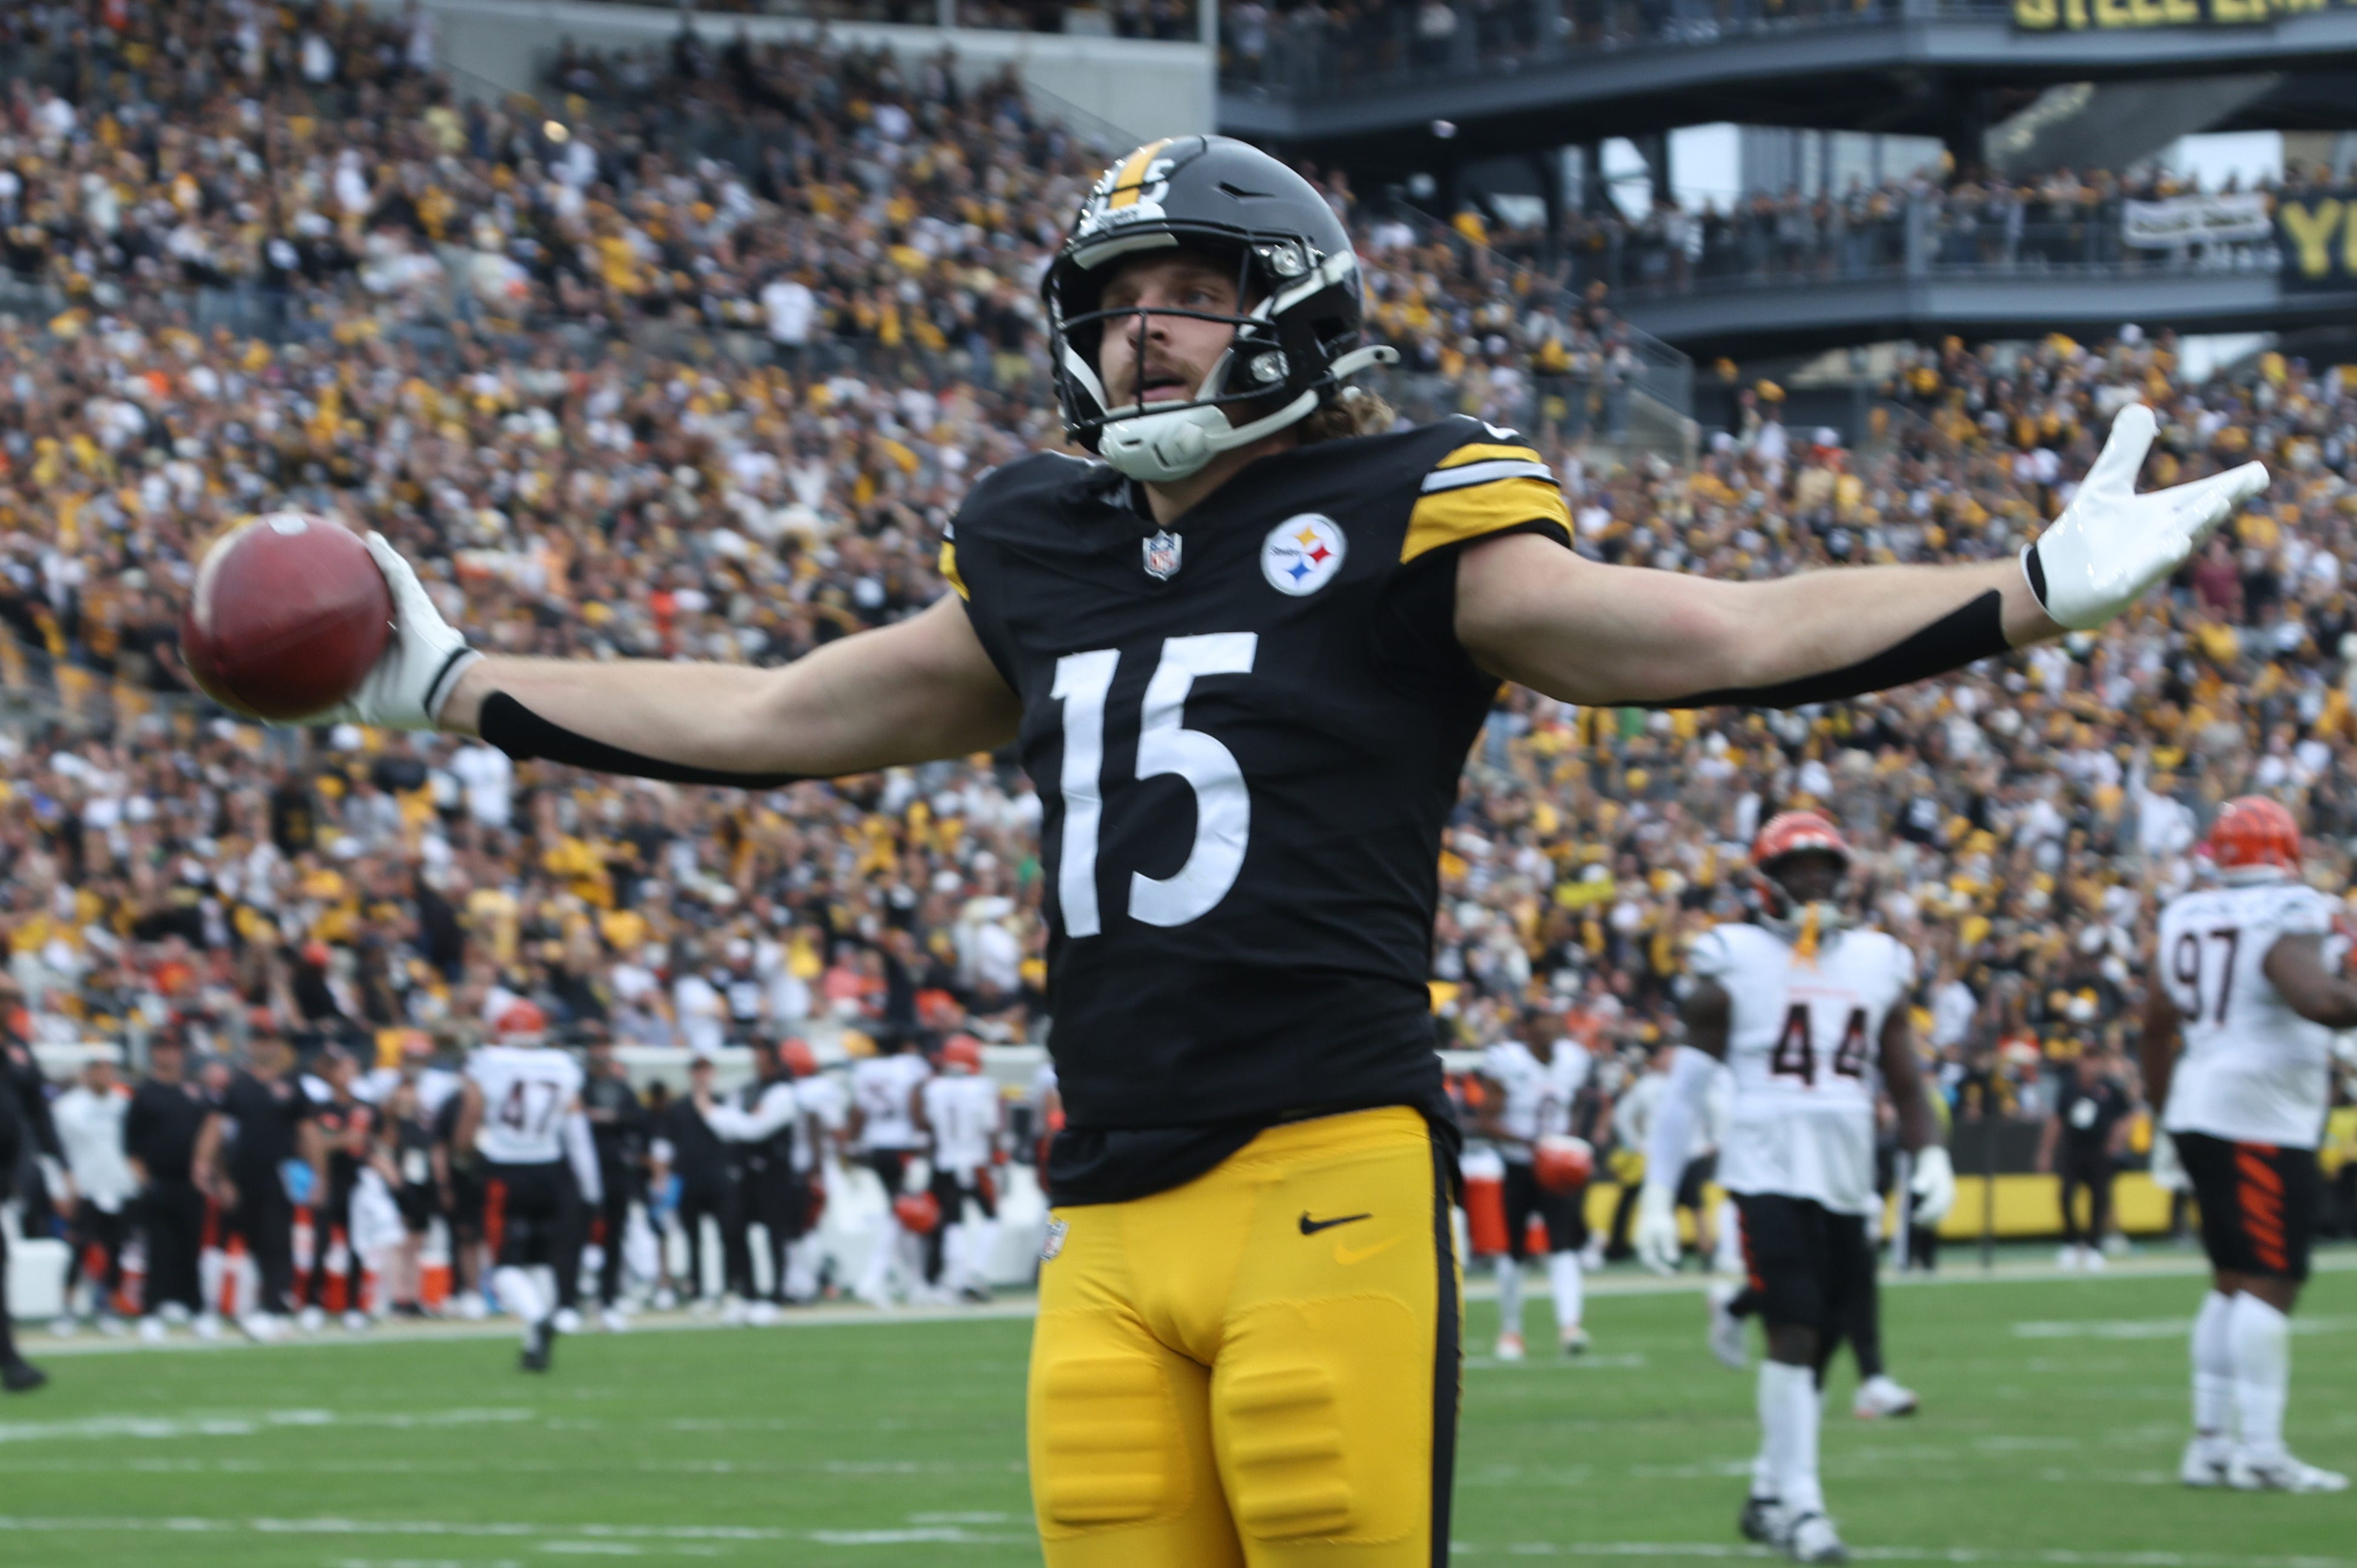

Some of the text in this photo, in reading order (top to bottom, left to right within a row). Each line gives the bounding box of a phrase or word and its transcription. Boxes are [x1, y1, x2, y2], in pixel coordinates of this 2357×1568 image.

[1050, 631, 1259, 938] 15
[2173, 926, 2239, 1028] 97
[1770, 1003, 1868, 1087] 44
[500, 1080, 562, 1138] 47
